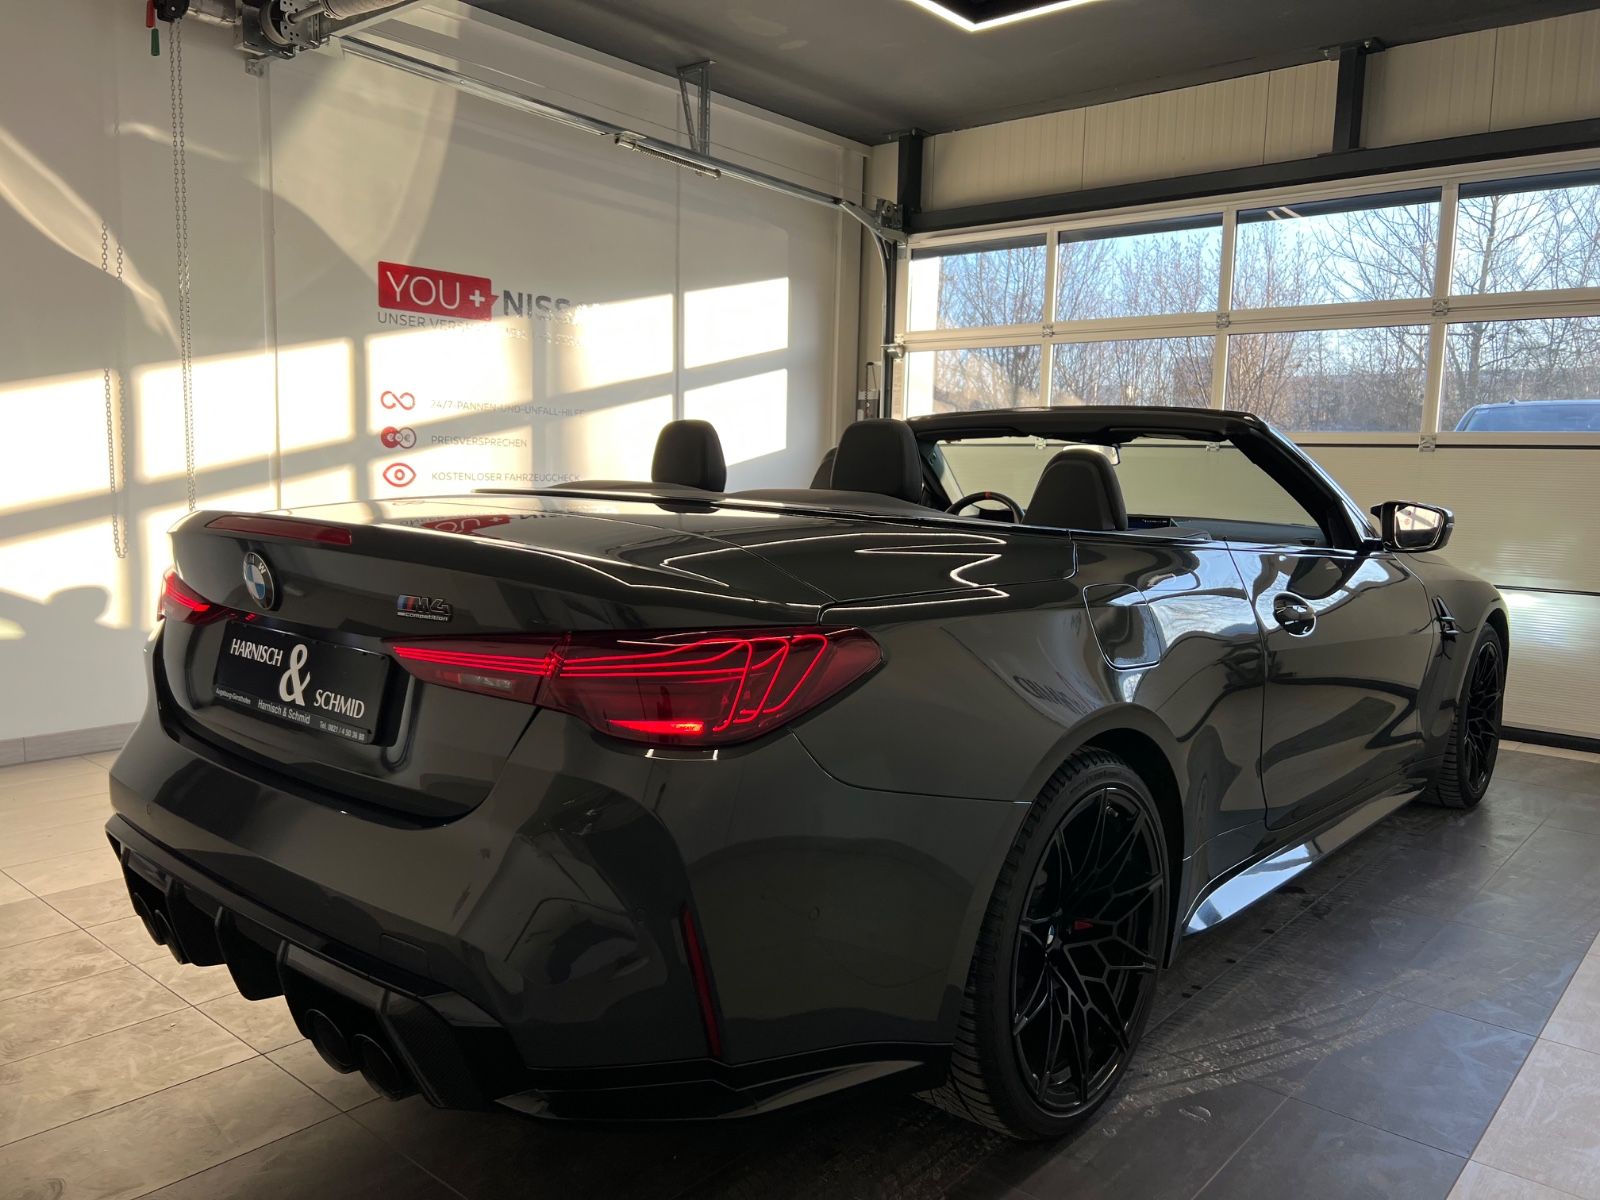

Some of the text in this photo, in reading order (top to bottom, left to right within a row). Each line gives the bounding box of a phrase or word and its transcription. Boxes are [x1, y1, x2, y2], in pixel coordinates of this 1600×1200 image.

[386, 271, 461, 310] YOU
[503, 289, 580, 321] NISS
[377, 311, 426, 328] UNSER
[431, 435, 528, 448] PREISVERSPRECHEN
[431, 472, 502, 481] KOSTENLOSER
[230, 638, 365, 719] HARNISCH & SCHMID
[257, 699, 282, 716] Harnisch
[287, 708, 311, 724] Schmid
